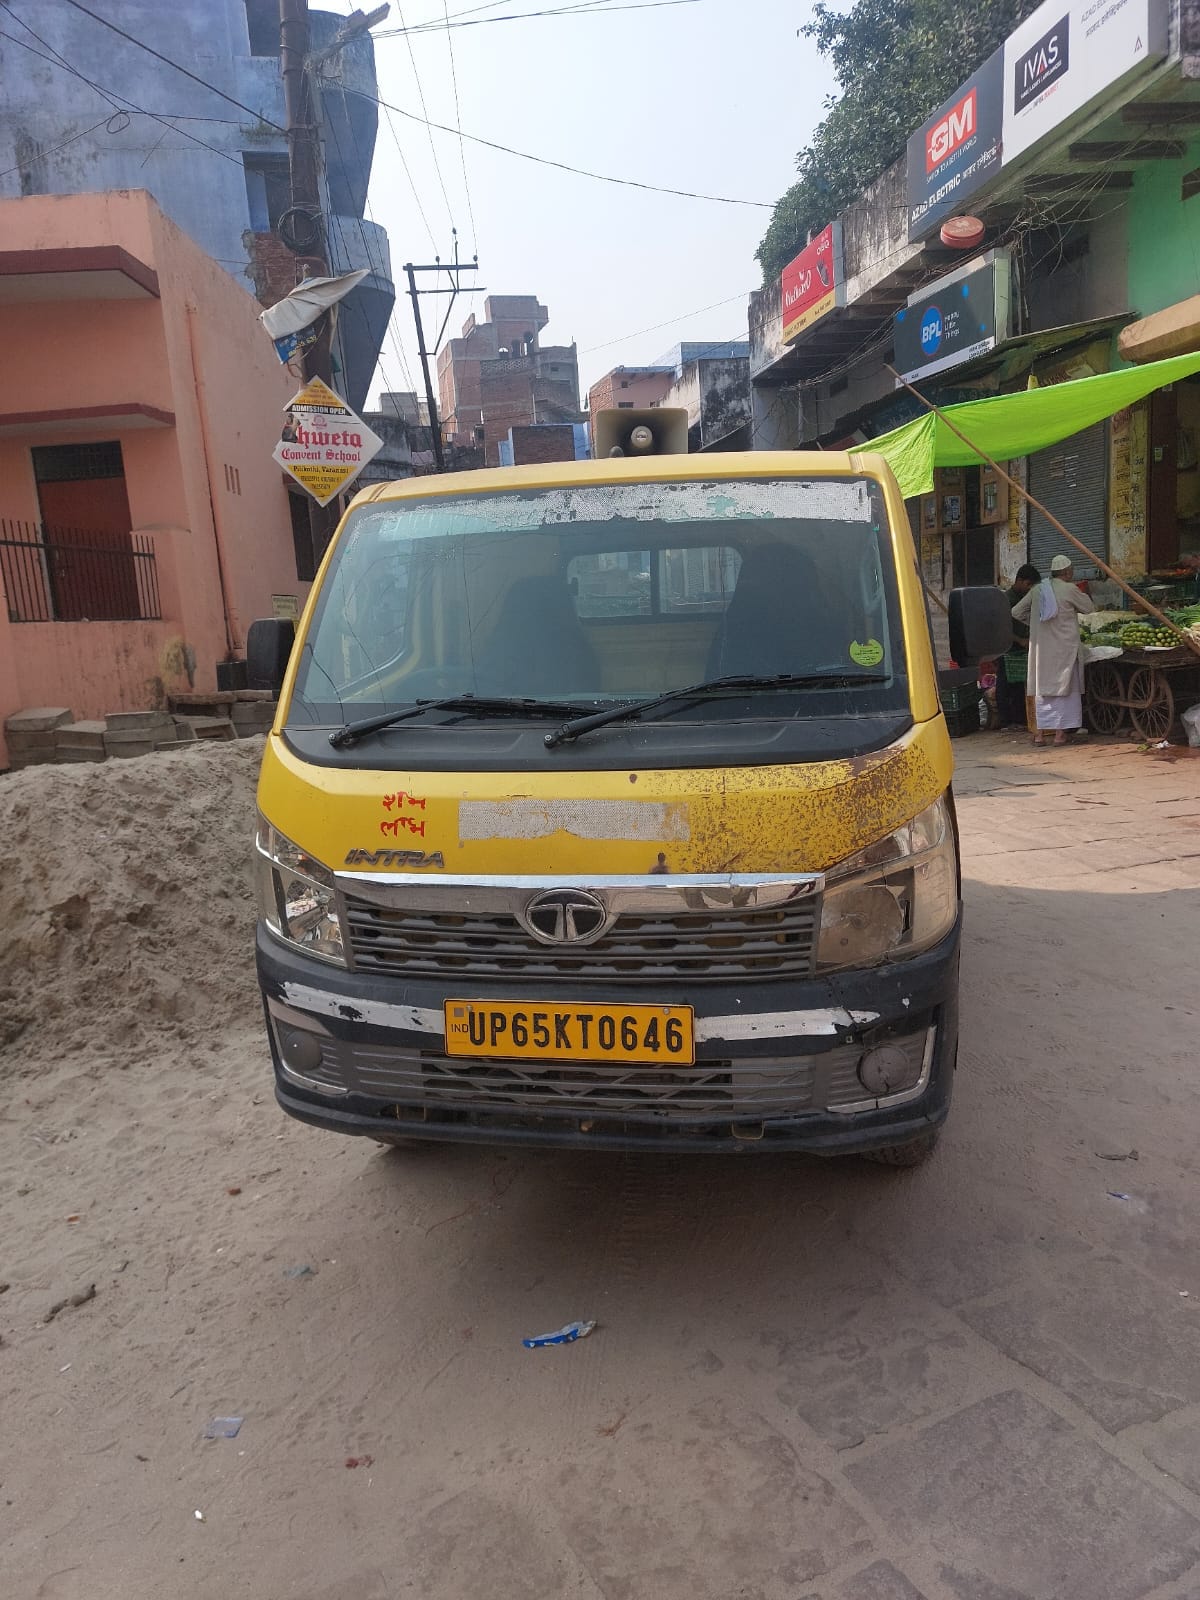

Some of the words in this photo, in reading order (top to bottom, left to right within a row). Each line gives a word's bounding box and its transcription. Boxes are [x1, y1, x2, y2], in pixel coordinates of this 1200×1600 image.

[1023, 35, 1059, 88] IVAS
[928, 96, 973, 163] GM
[929, 173, 961, 207] ELECTRIC
[922, 319, 942, 344] BPL
[291, 403, 329, 414] ADMISSION
[329, 407, 347, 415] OPEN
[281, 447, 322, 461] Convent
[325, 449, 362, 463] School
[344, 848, 445, 868] INTRA
[451, 1023, 469, 1033] IND
[468, 1011, 684, 1054] UP65KT0646
